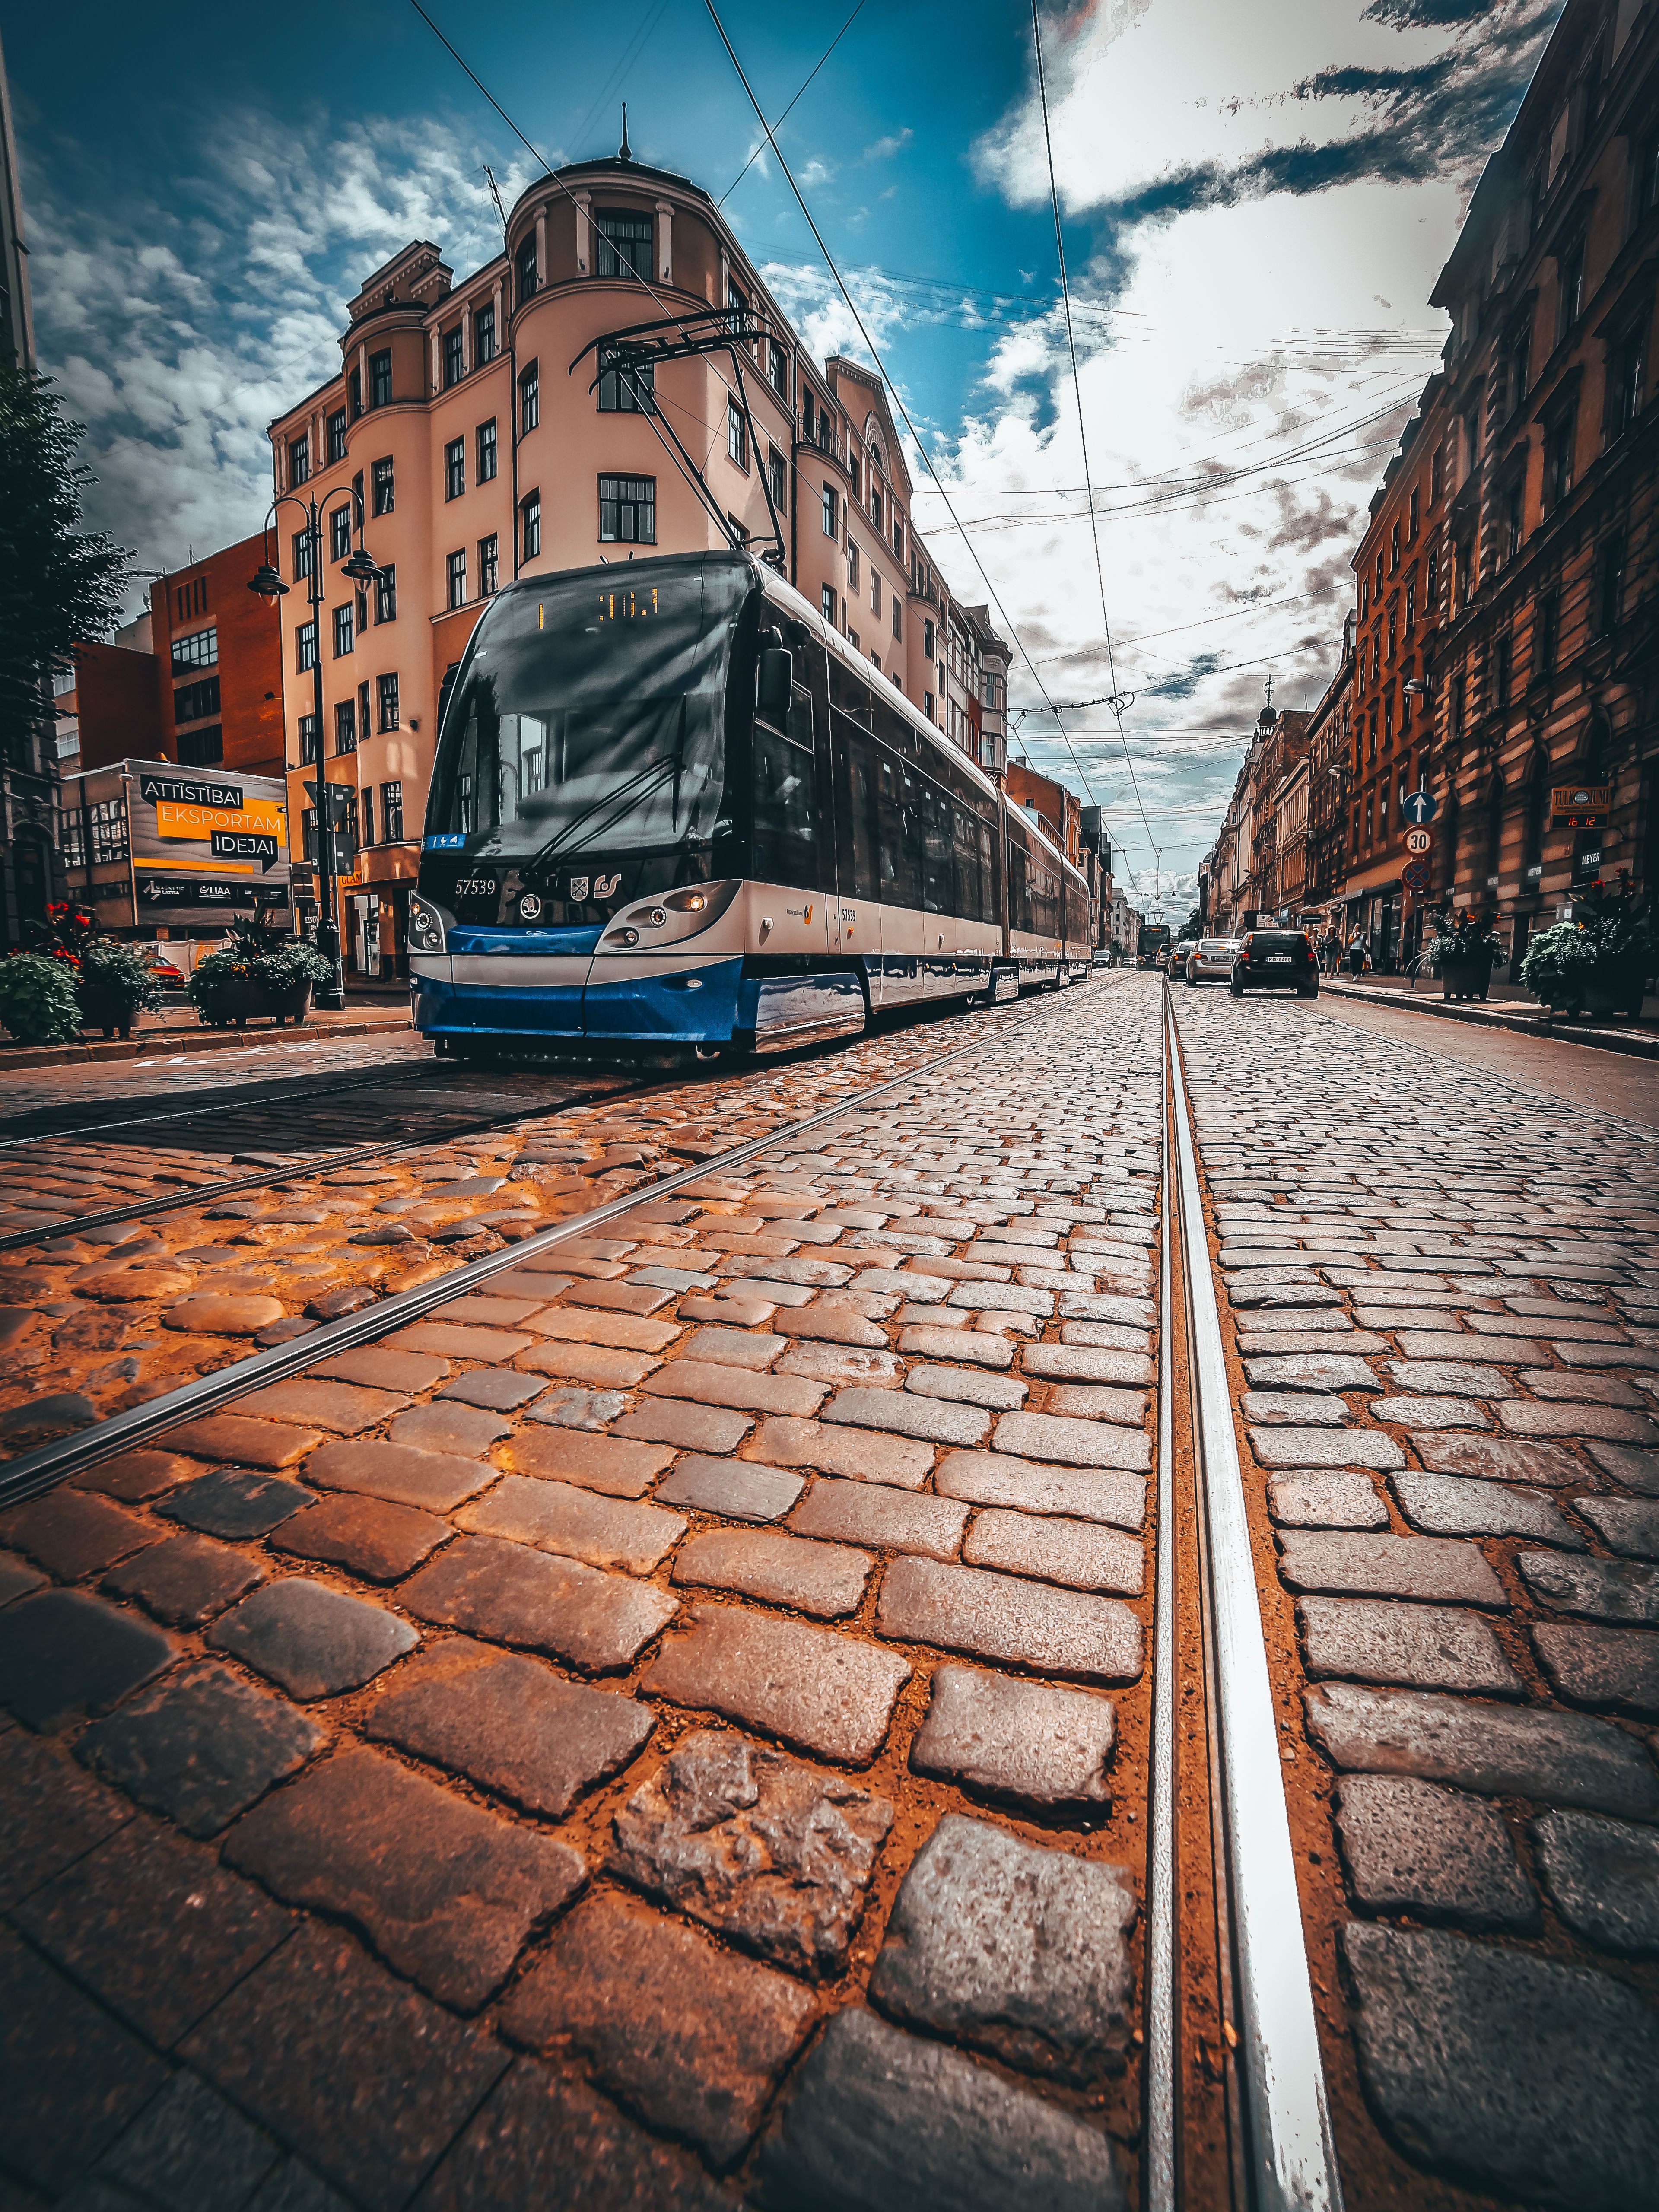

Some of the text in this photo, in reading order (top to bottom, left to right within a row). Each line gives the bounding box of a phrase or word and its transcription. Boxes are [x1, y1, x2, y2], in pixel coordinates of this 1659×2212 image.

[145, 782, 240, 806] ATTĪSTĪBAI
[162, 806, 280, 832] EKSPORTAM
[216, 836, 273, 855] IDEJAI
[1411, 834, 1426, 850] 30
[1582, 852, 1599, 864] MEYER
[210, 887, 231, 895] LIAA
[455, 880, 496, 895] 57539
[842, 909, 856, 922] 57539
